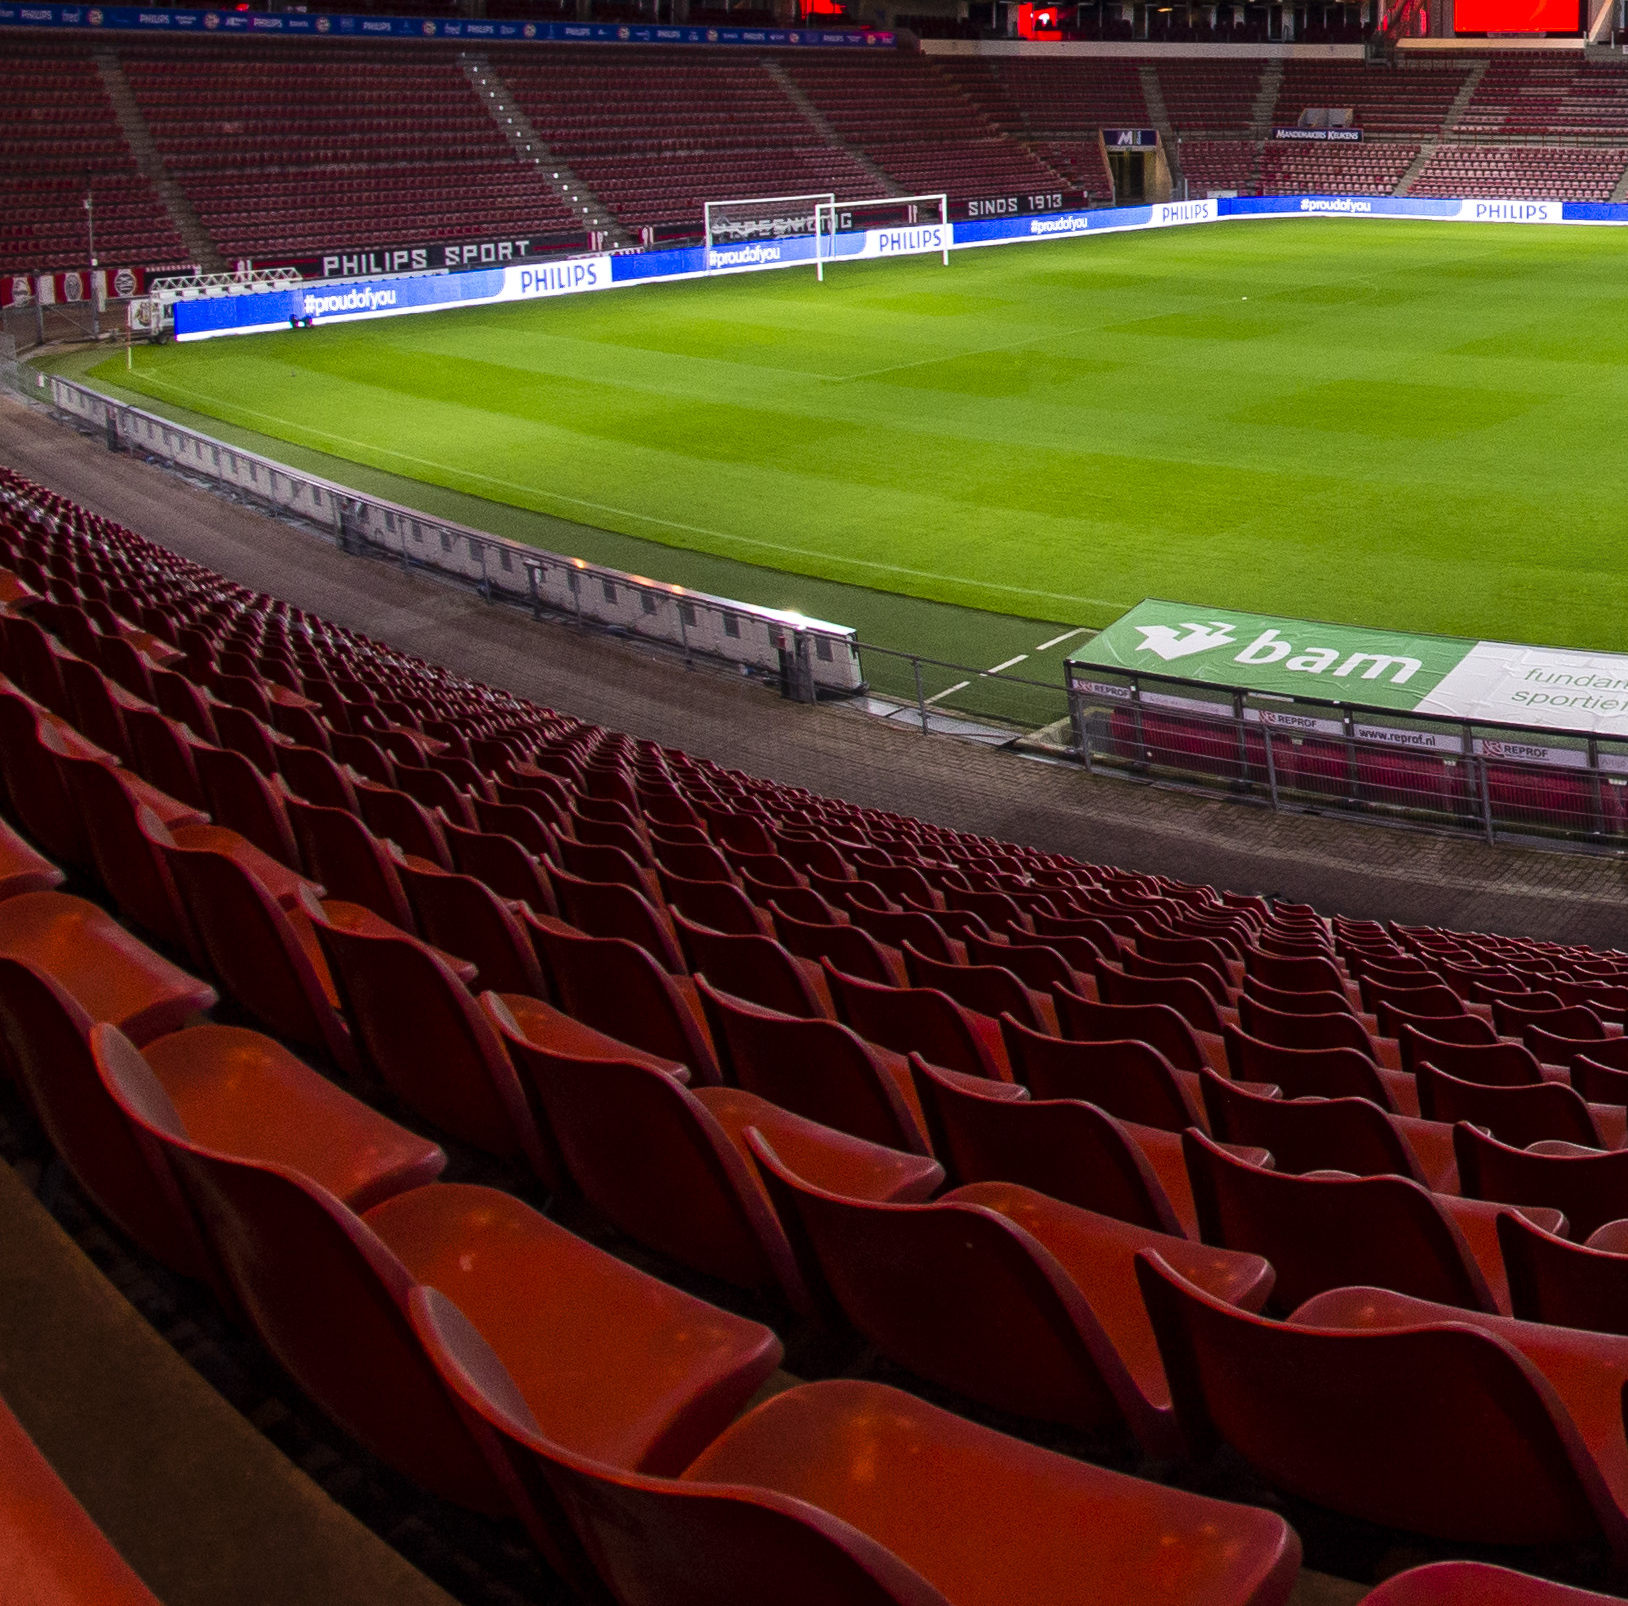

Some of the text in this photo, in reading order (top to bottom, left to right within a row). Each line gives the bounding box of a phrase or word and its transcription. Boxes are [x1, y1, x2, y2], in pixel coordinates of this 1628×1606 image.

[969, 194, 1063, 216] SINDS 1913
[1162, 203, 1209, 222] PHILIPS
[1300, 197, 1371, 213] #proudofyou
[1476, 203, 1548, 221] PHILIPS
[879, 228, 942, 253] PHILIPS
[323, 240, 530, 276] PHILIPS SPORT
[521, 263, 597, 293] PHILIPS
[304, 289, 396, 316] #proudofyou
[1233, 629, 1423, 684] bam
[1278, 715, 1318, 729] REPROF
[1359, 728, 1436, 747] www.reprof.nl
[1503, 744, 1549, 759] REPROF
